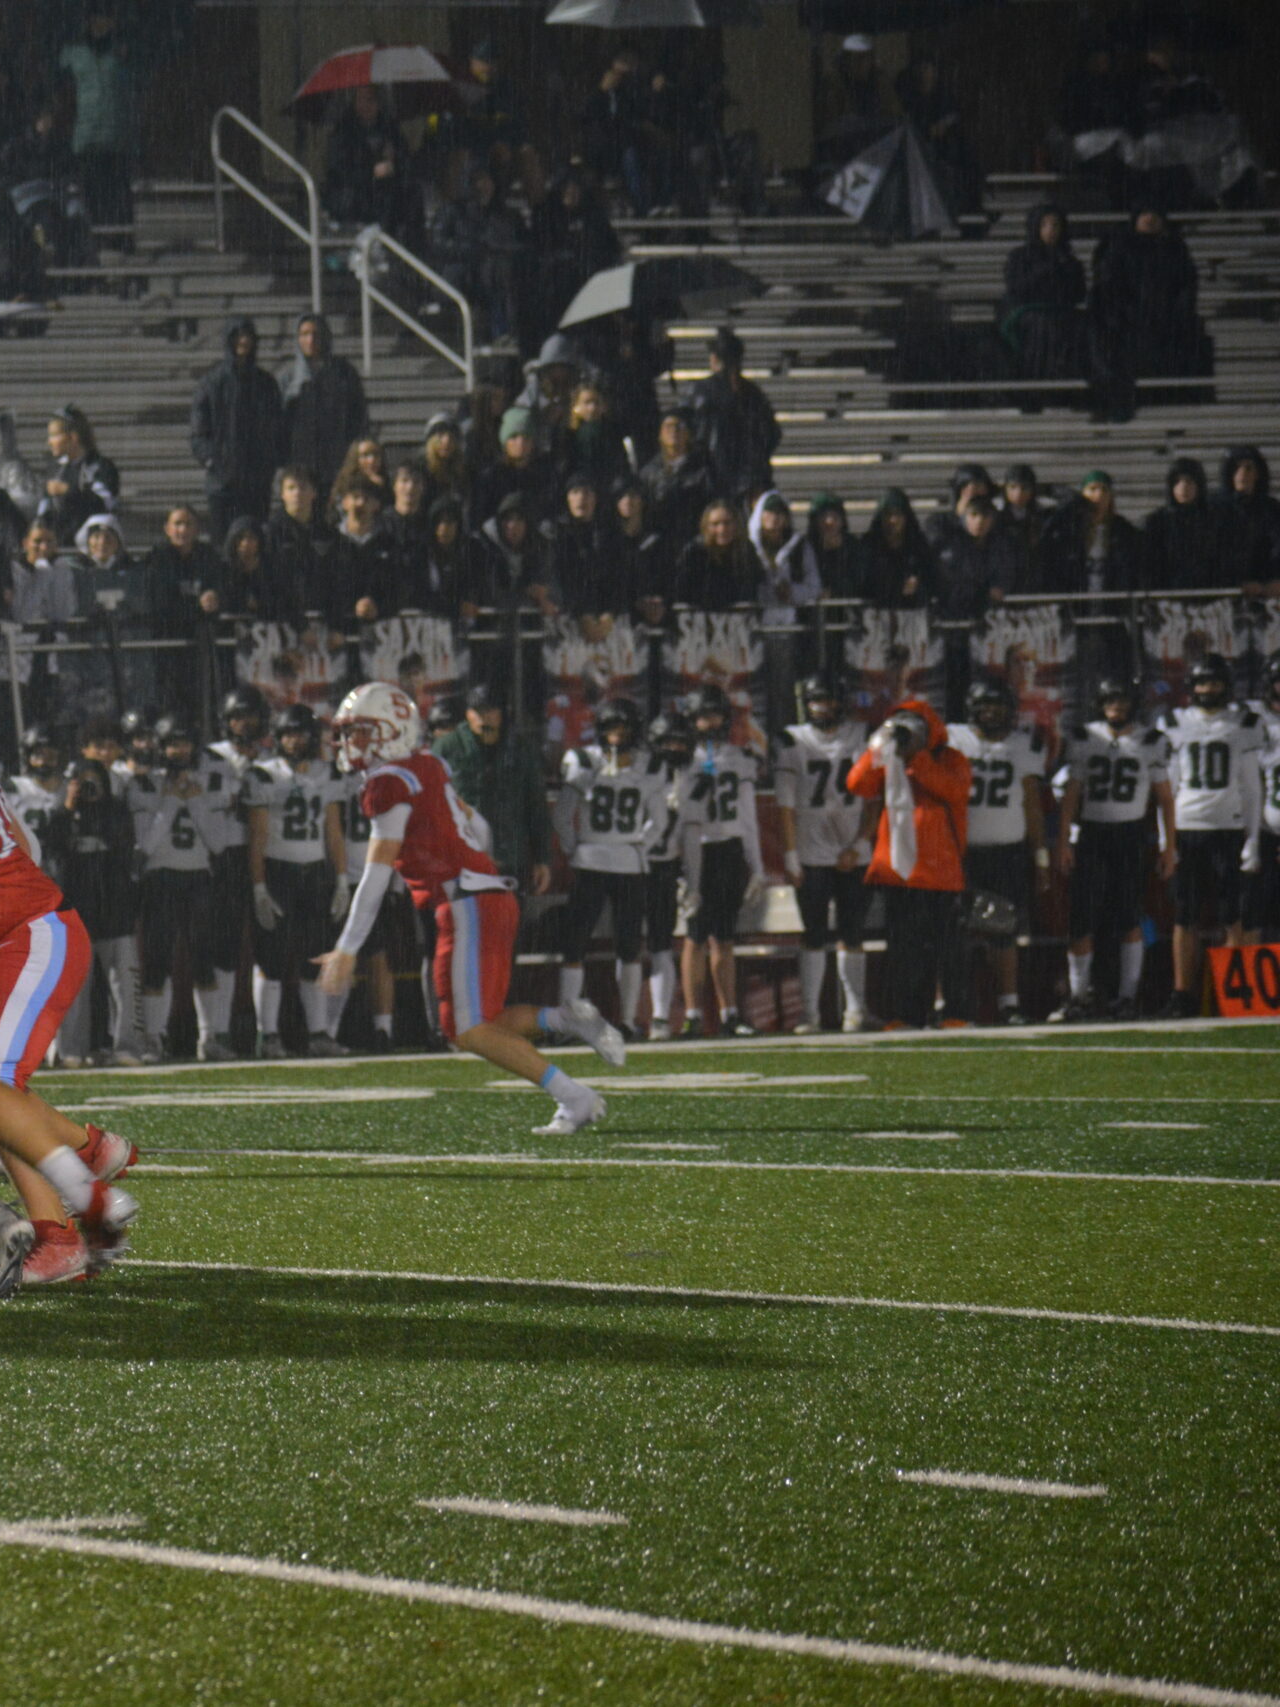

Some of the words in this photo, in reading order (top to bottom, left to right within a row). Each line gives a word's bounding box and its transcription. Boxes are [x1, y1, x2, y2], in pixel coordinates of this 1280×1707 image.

[1086, 755, 1140, 803] 26
[1188, 741, 1231, 790] 10
[590, 785, 641, 833] 89
[1223, 947, 1280, 1011] 40
